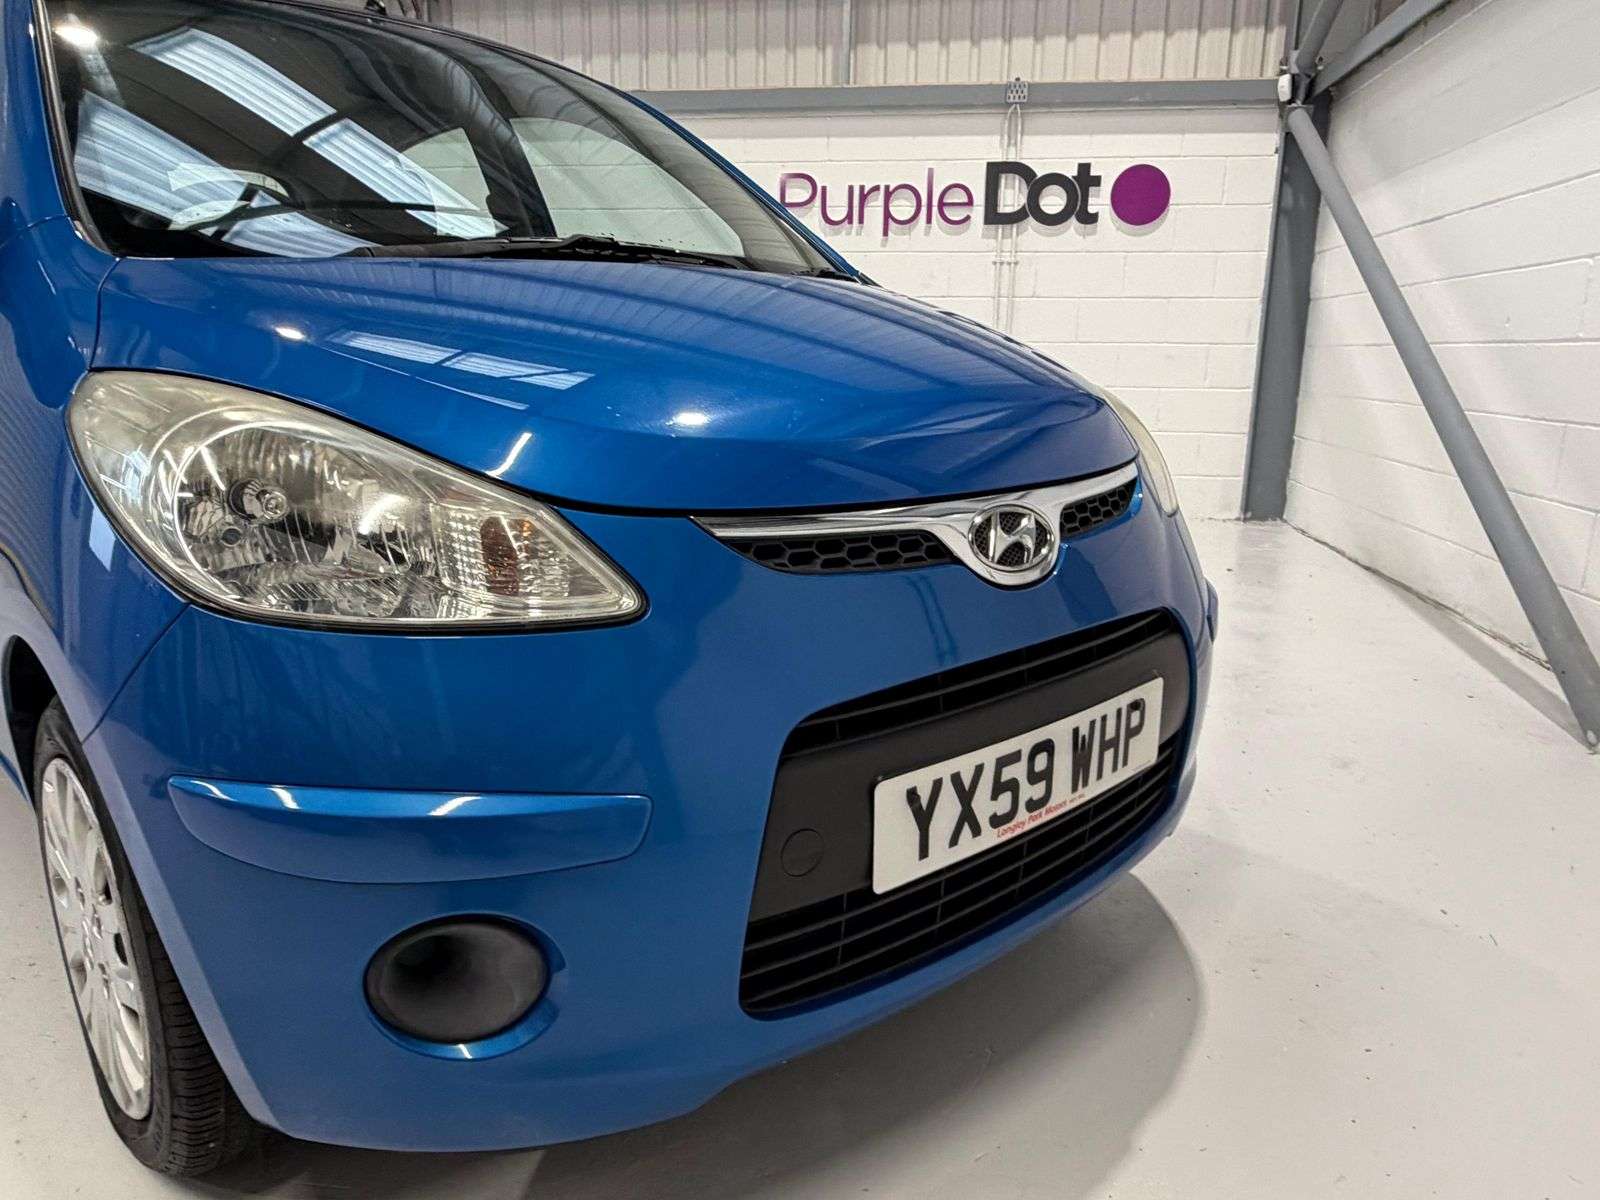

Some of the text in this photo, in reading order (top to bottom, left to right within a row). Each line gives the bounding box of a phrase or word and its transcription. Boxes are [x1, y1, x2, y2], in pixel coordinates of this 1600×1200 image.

[779, 161, 1101, 238] Purple Dot
[906, 698, 1146, 861] YX59 WHP
